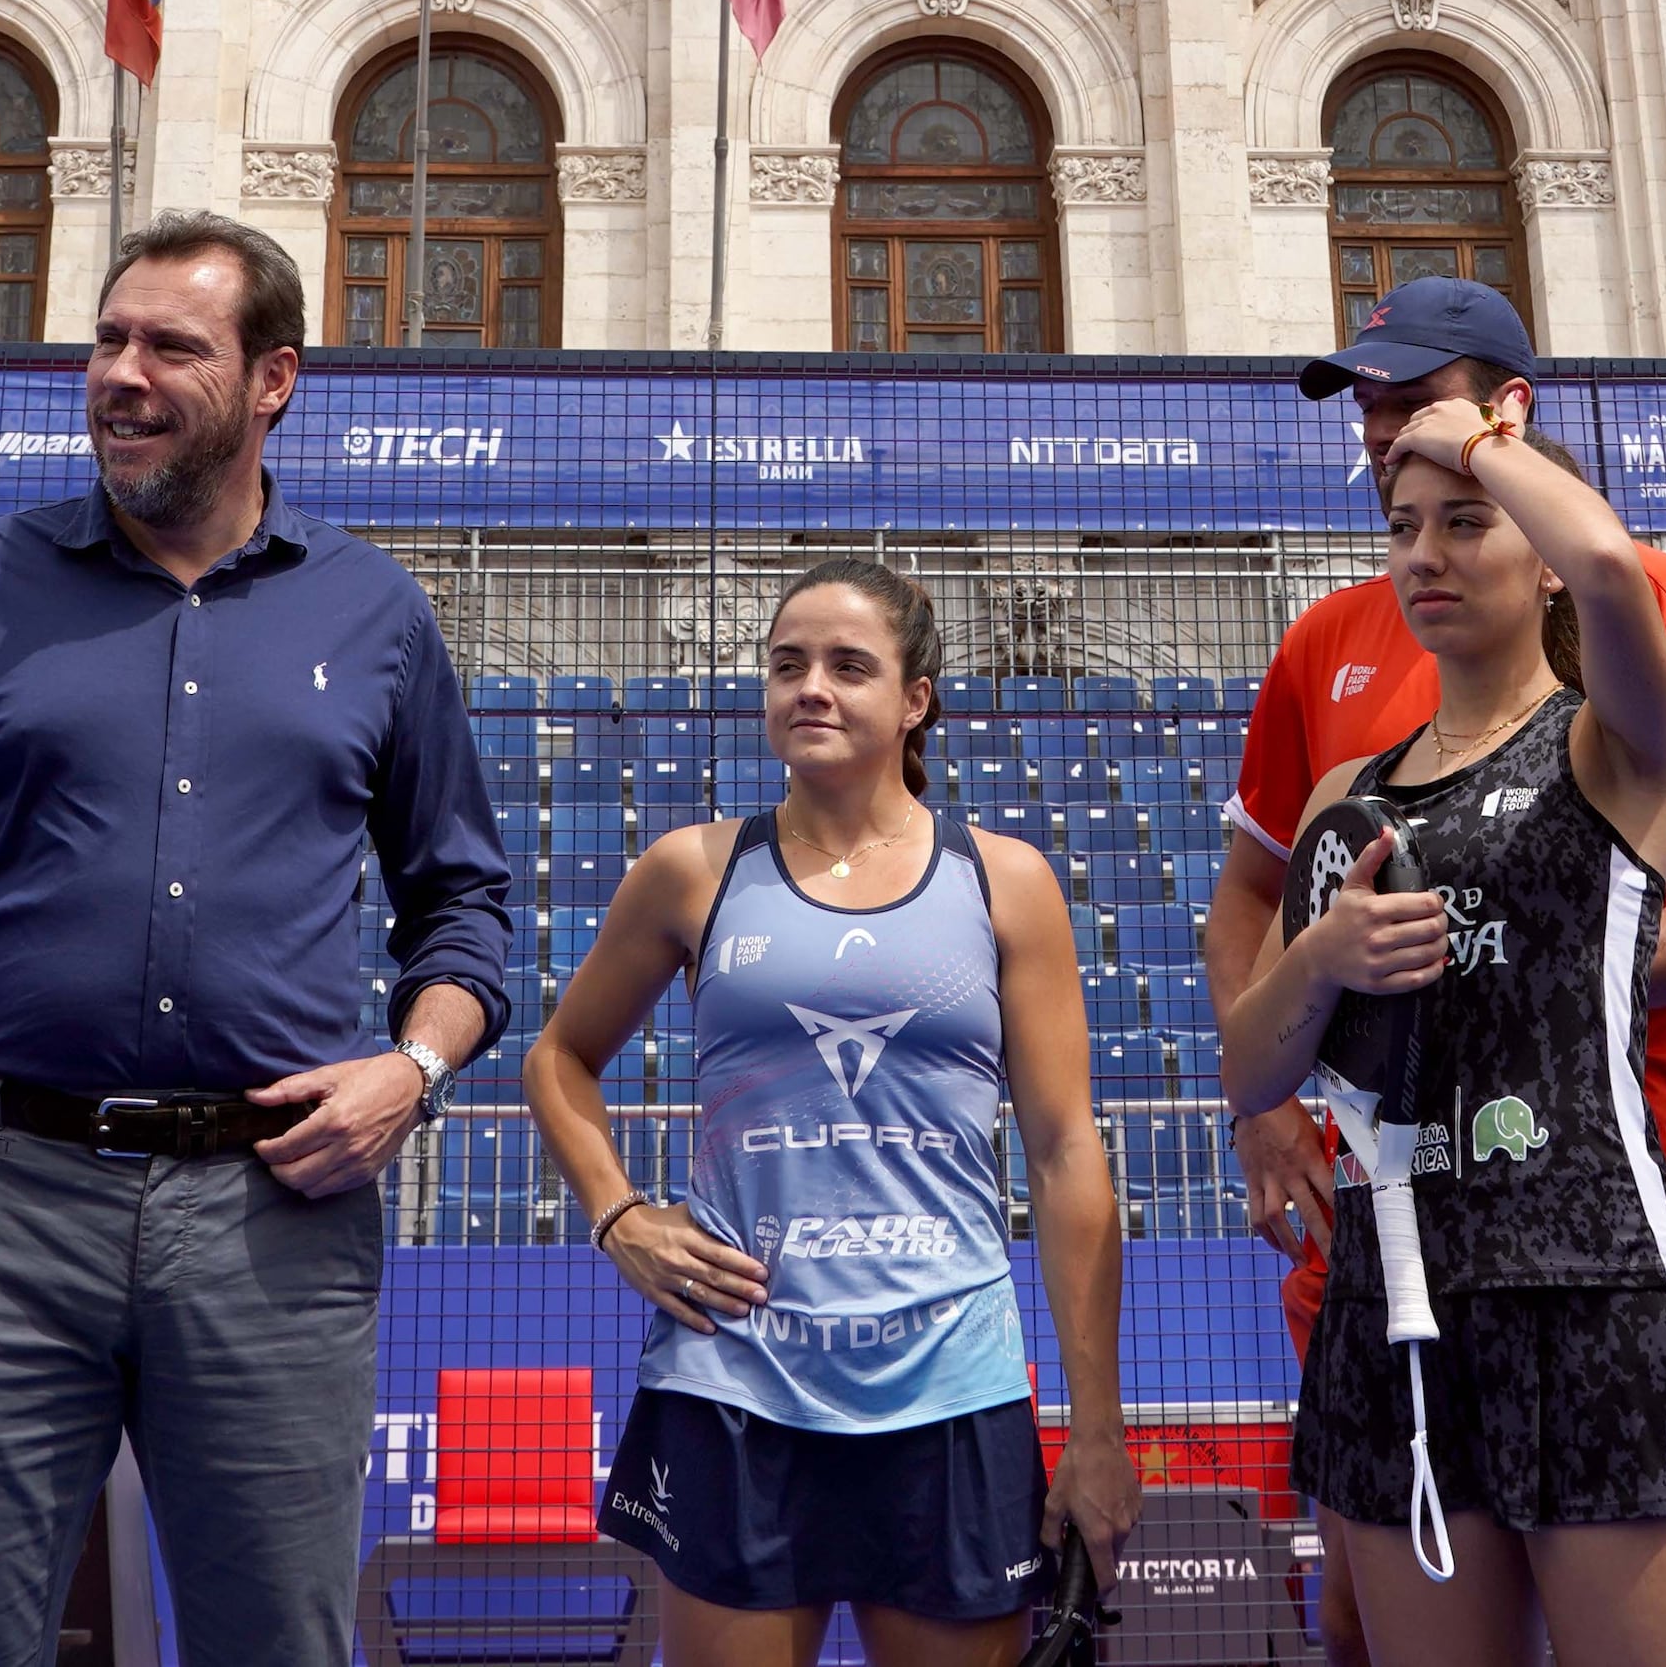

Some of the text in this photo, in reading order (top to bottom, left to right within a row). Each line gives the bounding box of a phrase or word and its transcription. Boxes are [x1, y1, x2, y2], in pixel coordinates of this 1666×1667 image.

[373, 427, 503, 466] TECH
[705, 435, 864, 462] ESTRELLA
[1010, 436, 1089, 464] NTT
[759, 466, 814, 480] DAMM
[1351, 665, 1378, 675] WORLD
[1347, 674, 1370, 686] PADEL
[1344, 684, 1365, 697] TOUR
[1503, 794, 1535, 804] PADEL
[1505, 787, 1539, 797] WORLD
[1502, 801, 1530, 812] TOUR
[738, 935, 772, 946] WORLD
[736, 943, 767, 957] PADEL
[735, 952, 762, 967] TOUR
[742, 1122, 957, 1156] CUPRA
[786, 1213, 958, 1242] PADEL
[779, 1236, 958, 1261] NUESTRO
[612, 1491, 680, 1553] Extremadura
[1115, 1558, 1258, 1581] VICTORIA
